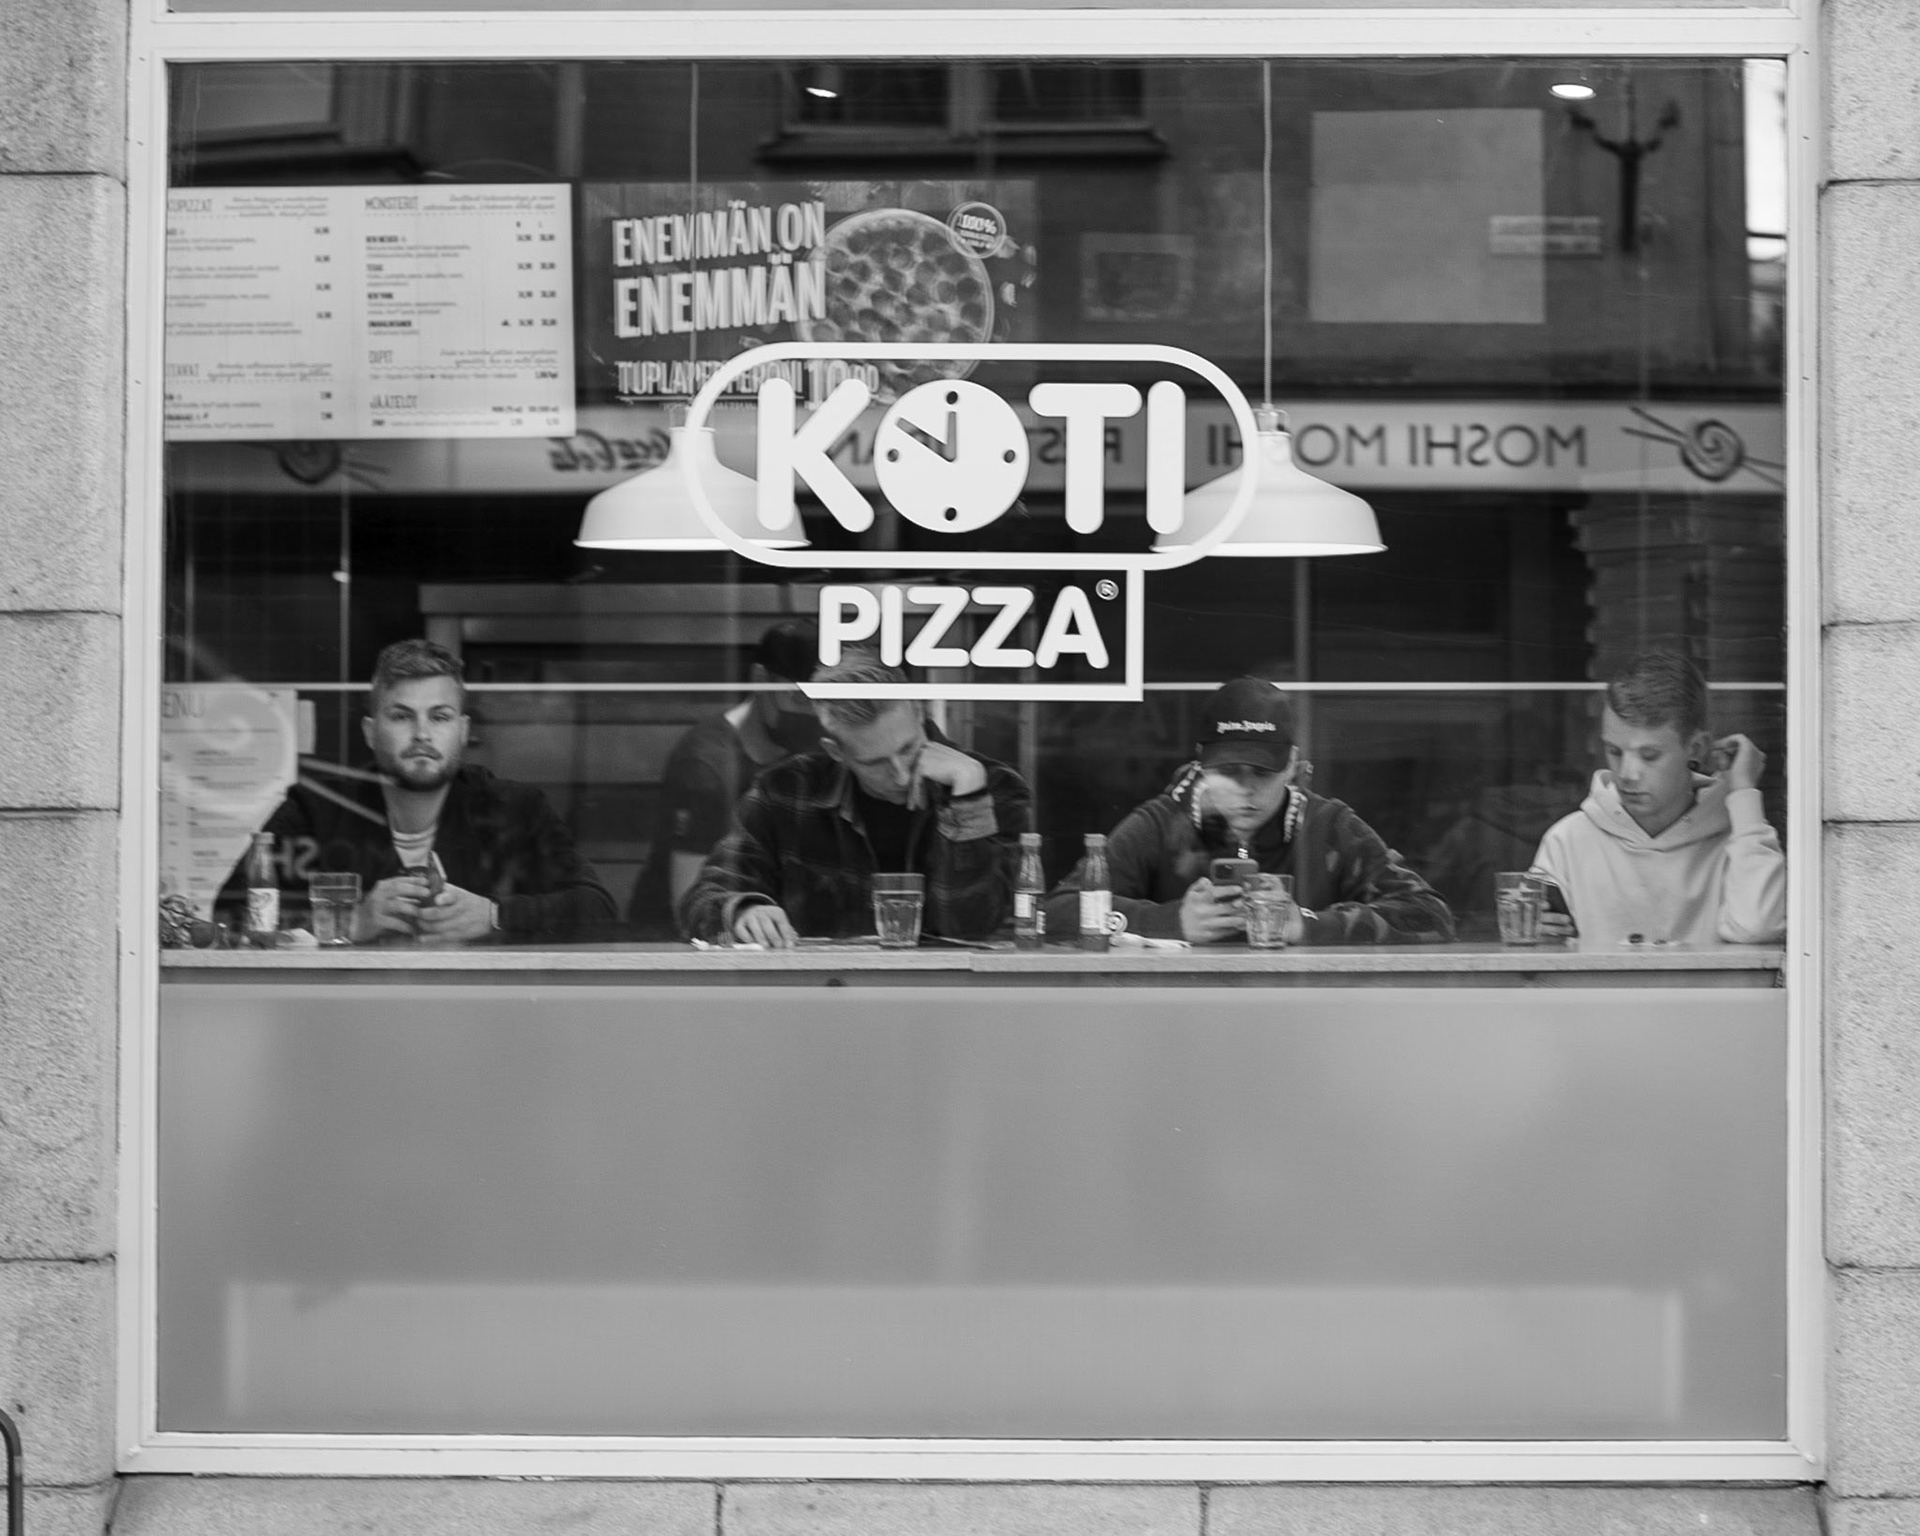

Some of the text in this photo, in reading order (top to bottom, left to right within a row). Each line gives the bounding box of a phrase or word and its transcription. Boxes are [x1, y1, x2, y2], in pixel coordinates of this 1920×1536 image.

[612, 200, 825, 267] ENEMMÄN ON
[613, 252, 827, 339] ENEMMÄN
[757, 377, 1186, 535] KOTI
